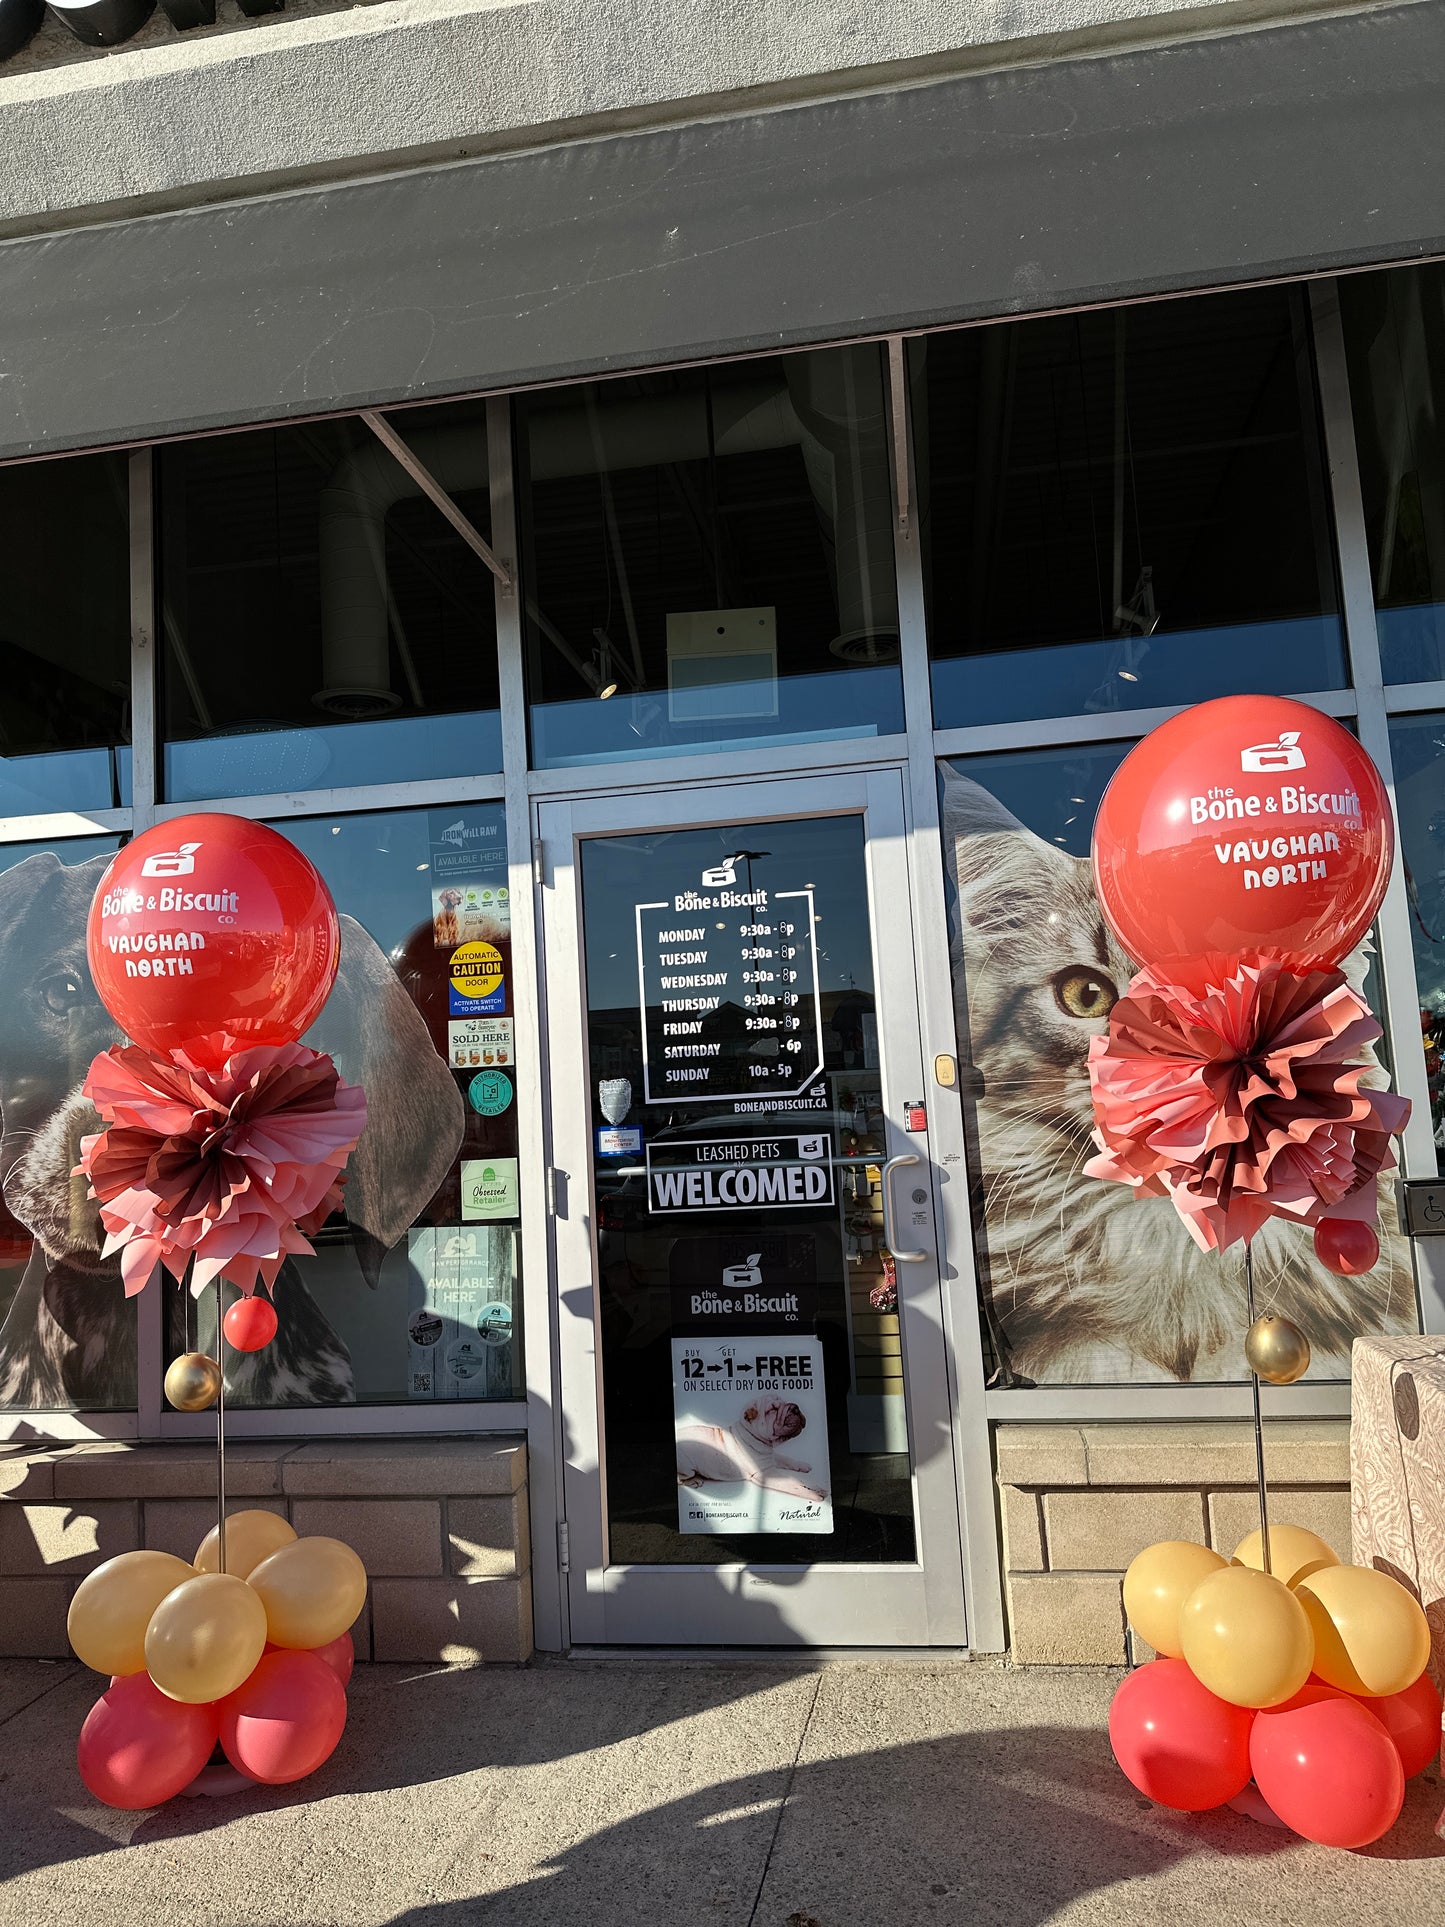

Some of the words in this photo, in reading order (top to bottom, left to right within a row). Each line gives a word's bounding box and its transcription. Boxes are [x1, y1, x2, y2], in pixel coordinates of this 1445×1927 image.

[1207, 786, 1234, 800] the
[1190, 795, 1261, 825] Bone
[1265, 796, 1279, 813] &
[1281, 785, 1361, 817] Biscuit
[480, 825, 497, 837] RAW
[438, 854, 478, 866] AVAILABLE
[480, 851, 505, 862] HERE
[113, 886, 129, 898] the
[684, 891, 698, 899] the
[102, 894, 144, 919] Bone
[146, 895, 157, 910] &
[160, 887, 239, 913] Biscuit
[674, 895, 711, 912] Bone
[712, 897, 720, 907] &
[720, 889, 768, 908] Biscuit
[658, 928, 706, 943] MONDAY
[740, 924, 771, 937] 9:30a
[780, 921, 795, 936] 8p
[453, 951, 499, 961] AUTOMATIC
[659, 951, 708, 966] TUESDAY
[741, 947, 773, 960] 9:30a
[781, 945, 796, 960] 8p
[453, 962, 501, 976] CAUTION
[465, 978, 489, 987] DOOR
[660, 972, 728, 989] WEDNESDAY
[742, 970, 774, 983] 9:30a
[782, 968, 797, 983] 8p
[662, 996, 720, 1013] THURSDAY
[744, 994, 776, 1007] 9:30a
[784, 991, 799, 1006] 8p
[663, 1021, 703, 1036] FRIDAY
[745, 1017, 777, 1031] 9:30a
[785, 1015, 800, 1030] 8p
[452, 1034, 480, 1044] SOLD
[482, 1032, 510, 1042] HERE
[664, 1043, 721, 1059] SATURDAY
[786, 1039, 802, 1053] 6p
[665, 1067, 710, 1082] SUNDAY
[748, 1065, 769, 1077] 10a
[777, 1063, 792, 1078] 5p
[734, 1098, 828, 1113] BONEANDBISCUIT.CA
[696, 1144, 749, 1162] LEASHED
[752, 1143, 780, 1159] PETS
[472, 1184, 507, 1197] Obsessed
[654, 1166, 827, 1207] WELCOMED
[473, 1196, 506, 1205] Retailer
[427, 1277, 494, 1289] AVAILABLE
[444, 1291, 476, 1303] HERE
[701, 1290, 718, 1299] the
[691, 1295, 733, 1314] Bone
[734, 1300, 743, 1312] &
[744, 1292, 799, 1313] Biscuit
[685, 1349, 700, 1357] BUY
[721, 1348, 736, 1357] GET
[681, 1358, 705, 1378] 12
[723, 1358, 733, 1378] 1
[755, 1355, 813, 1377] FREE
[683, 1380, 697, 1392] ON
[700, 1379, 732, 1392] SELECT
[736, 1379, 754, 1391] DRY
[758, 1379, 779, 1391] DOG
[782, 1378, 814, 1390] FOOD!
[779, 1506, 821, 1520] Natural
